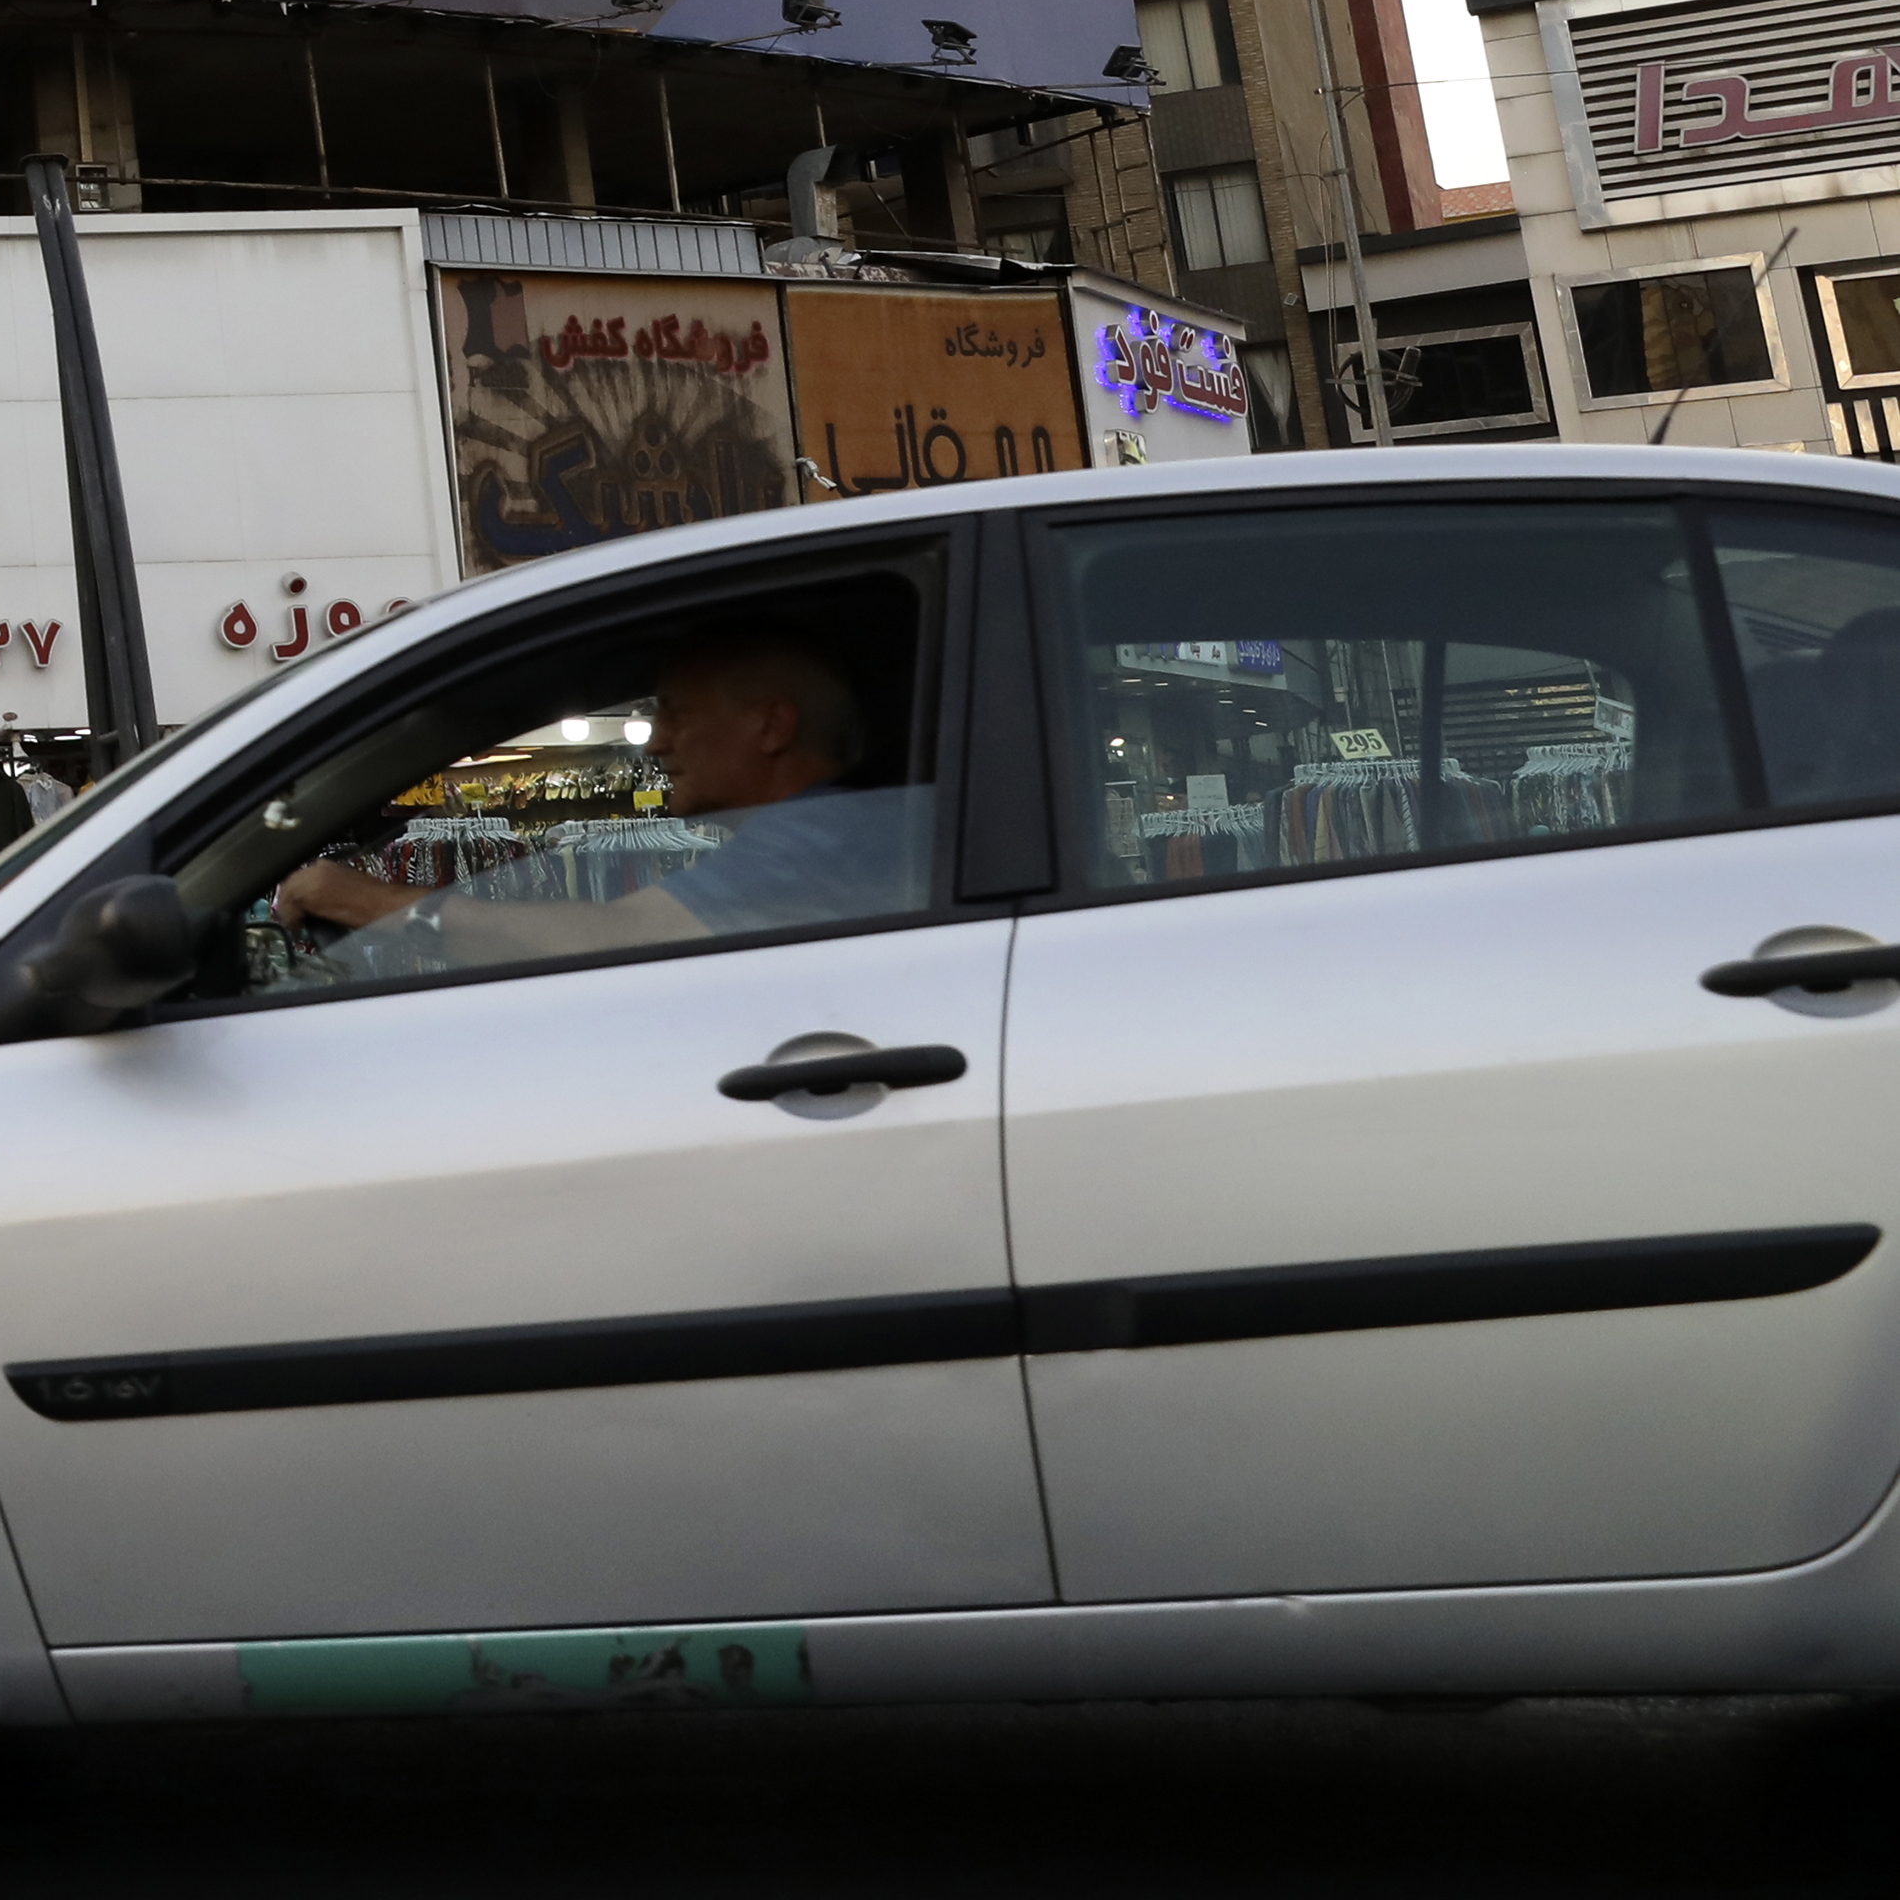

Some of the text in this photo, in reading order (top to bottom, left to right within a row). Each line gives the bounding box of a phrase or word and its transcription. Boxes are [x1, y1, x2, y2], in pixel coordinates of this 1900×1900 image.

[541, 313, 771, 374] فروشگاه کفش
[945, 322, 1046, 368] فروشگاه
[1115, 309, 1248, 417] فست فود
[221, 572, 419, 662] وزه
[1339, 732, 1383, 753] 295
